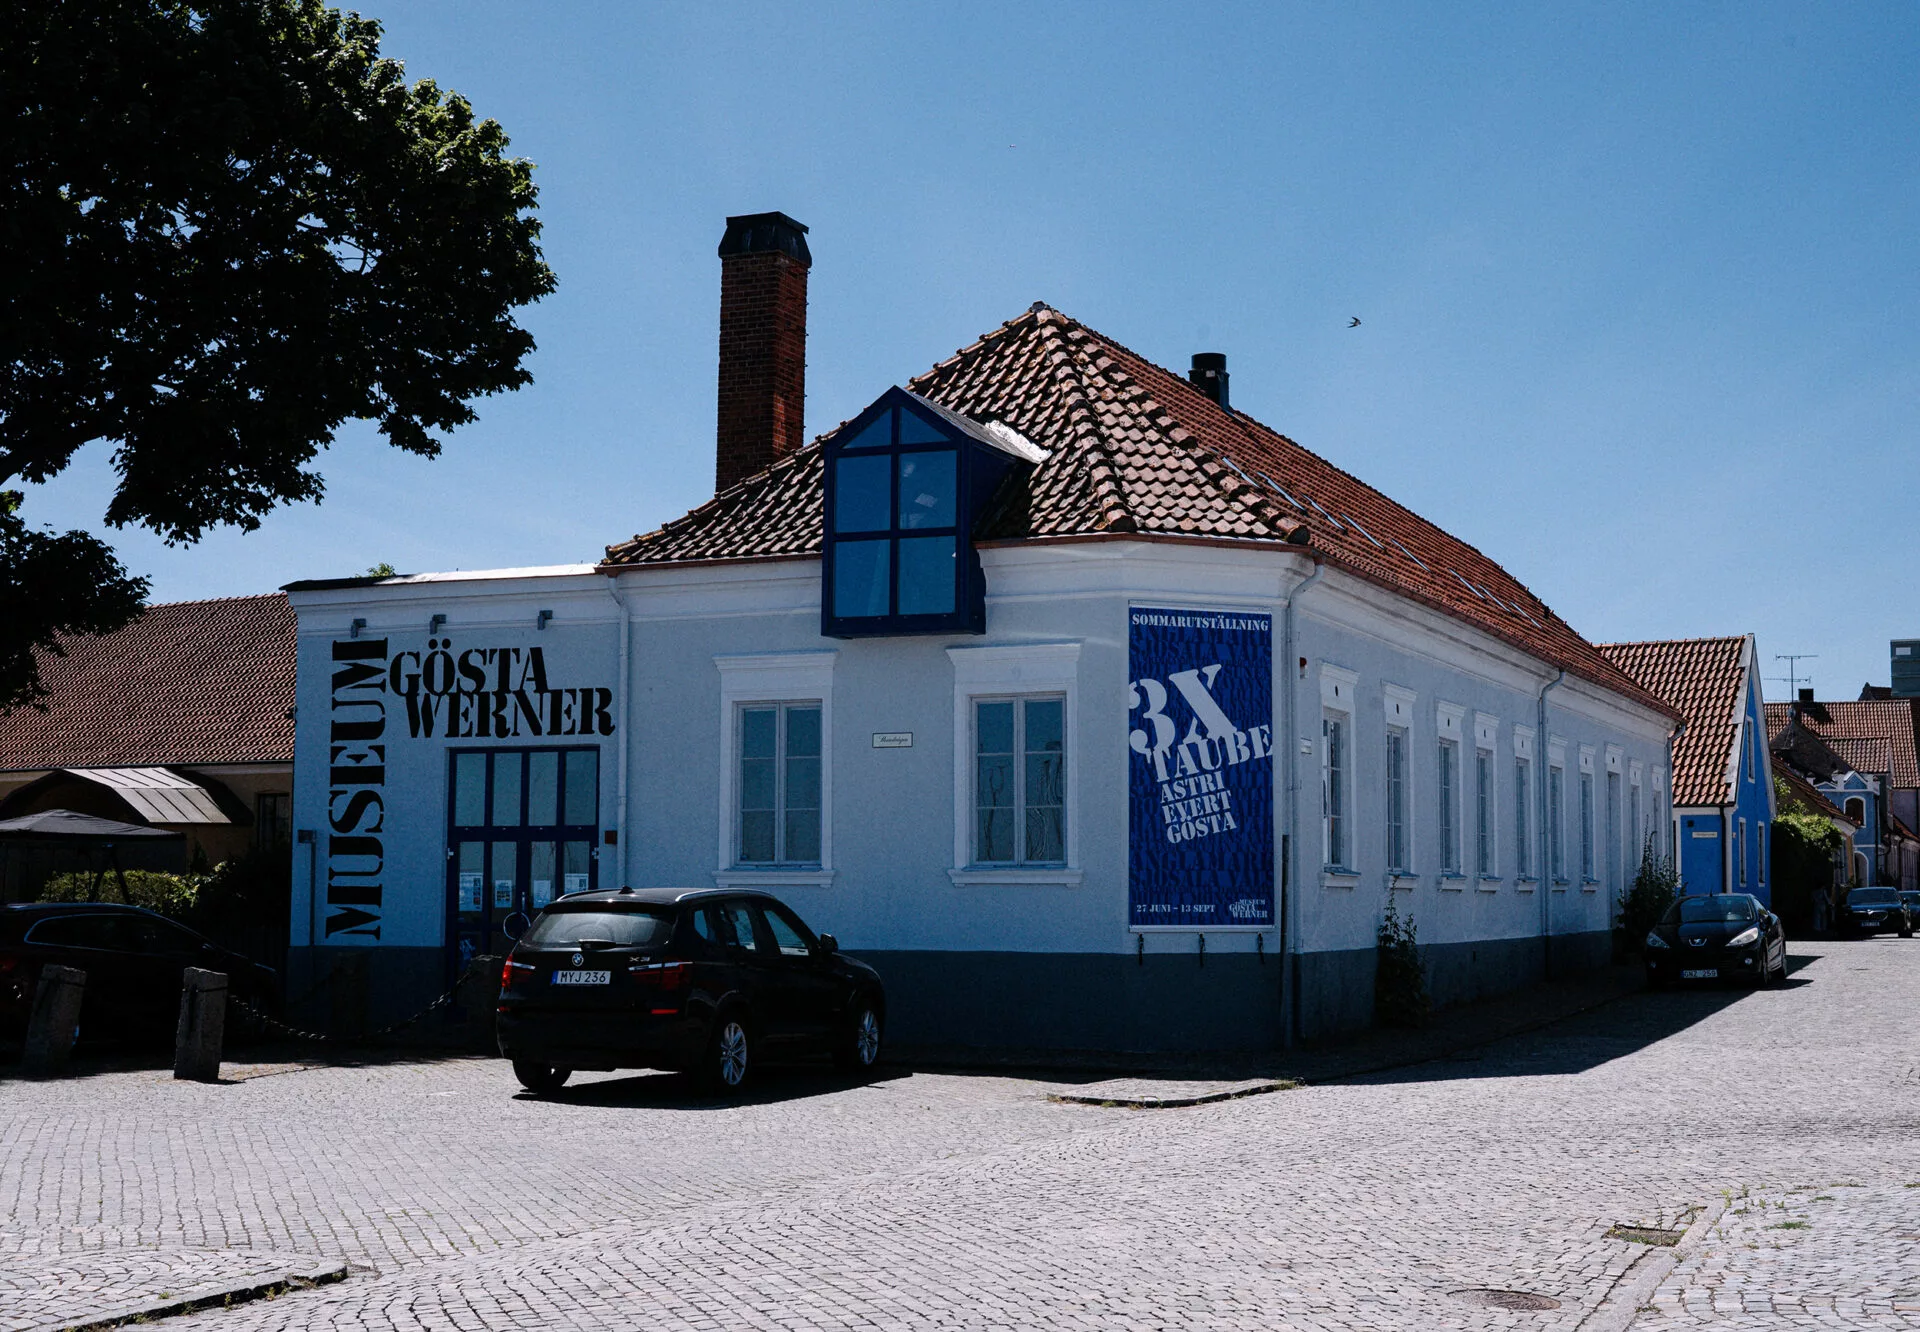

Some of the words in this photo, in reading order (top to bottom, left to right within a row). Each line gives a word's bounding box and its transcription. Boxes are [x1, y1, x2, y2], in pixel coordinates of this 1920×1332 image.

[1131, 613, 1269, 632] SOMMARUTSTÄLLNING
[389, 638, 549, 697] GÖSTA
[405, 687, 616, 739] WERNER
[1146, 724, 1273, 783] TAUBE
[325, 637, 388, 940] MUSEUM
[1160, 771, 1226, 804] ASTRI
[1161, 790, 1232, 825] EVERT
[1166, 811, 1237, 844] GÖSTA
[1136, 904, 1147, 913] 27
[1149, 904, 1171, 913] JUNI
[1180, 904, 1191, 913] 13
[1193, 904, 1216, 913] SEPT
[560, 972, 582, 983] MYJ
[584, 972, 606, 983] 236
